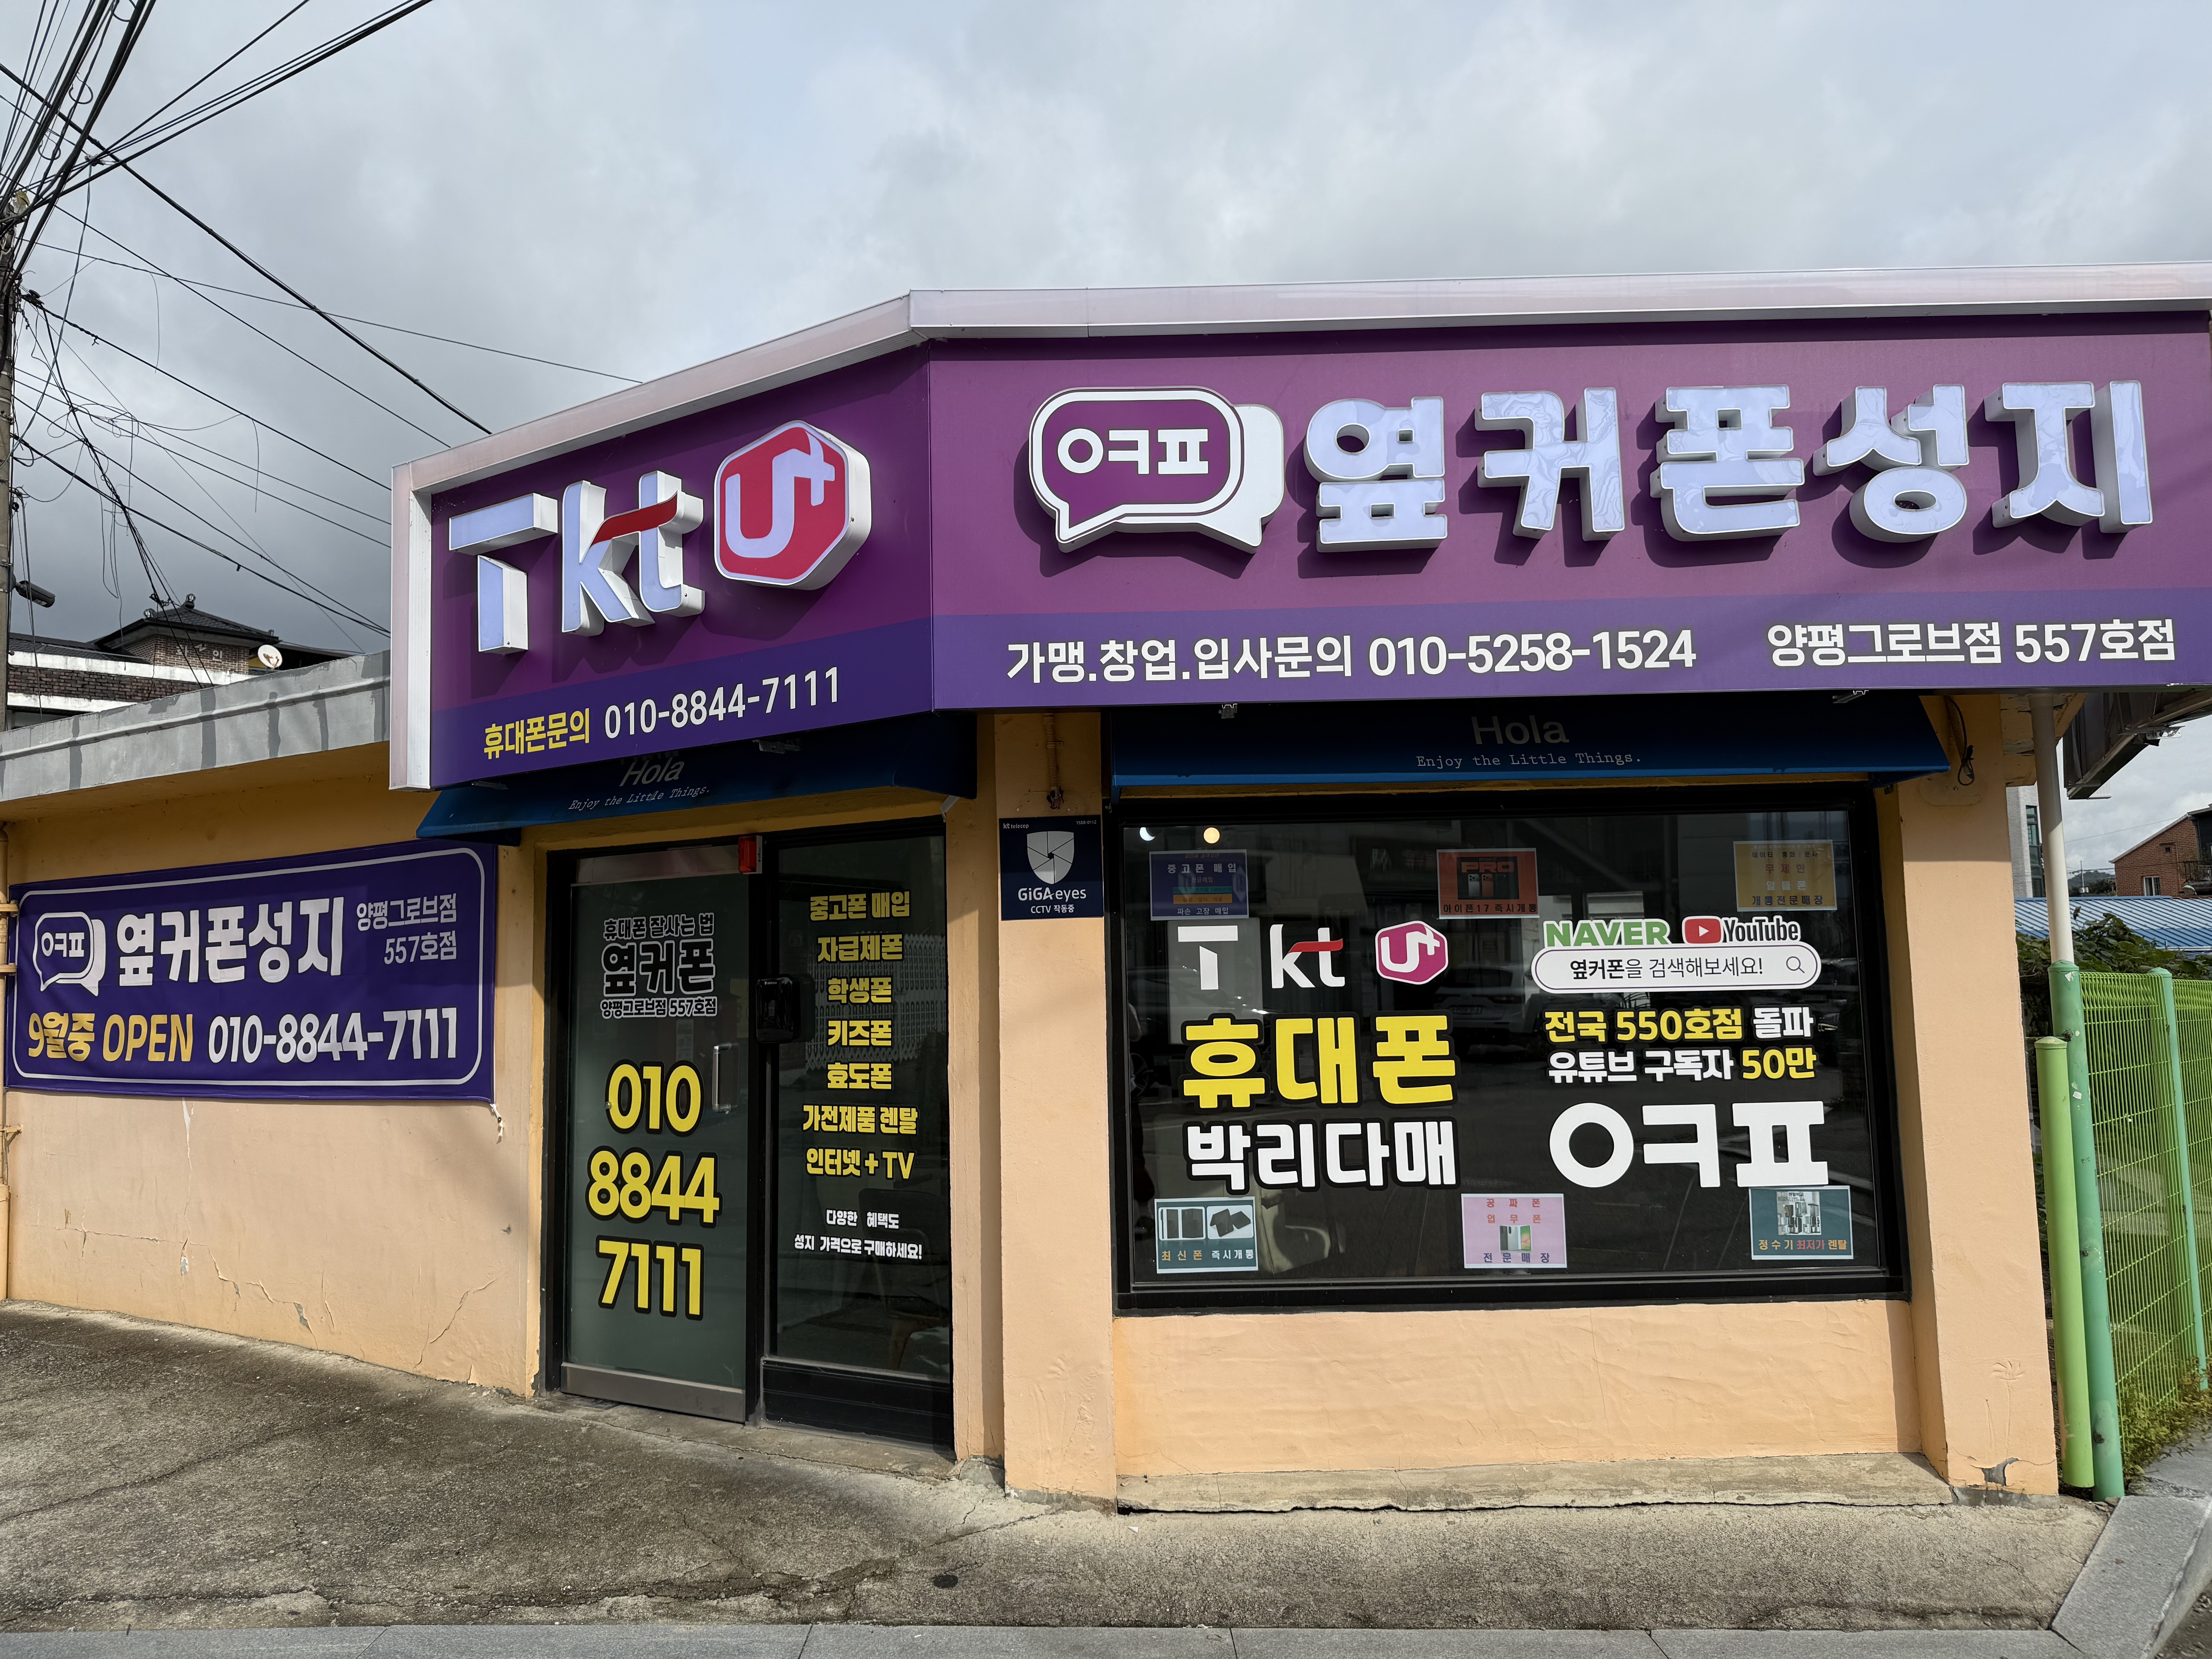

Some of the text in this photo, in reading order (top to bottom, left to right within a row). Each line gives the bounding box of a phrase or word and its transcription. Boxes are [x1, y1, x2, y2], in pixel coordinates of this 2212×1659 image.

[1304, 380, 2152, 552] 옆커폰성지
[562, 471, 704, 636] kt
[1007, 629, 1697, 683] 가맹.창업.입사문의 010-5258-1524
[1768, 618, 2176, 666] 양평그로브점 557호점
[483, 667, 839, 760] 휴대폰문의 010-8844-7111
[1472, 715, 1569, 745] Hola
[620, 758, 684, 787] Hola
[1416, 752, 1641, 769] Enjoy the Little Things.
[568, 786, 710, 811] Enjoy the Little Things.
[1214, 863, 1236, 873] 매입
[1461, 861, 1515, 873] PRO
[356, 893, 457, 932] 양평그로브점
[809, 891, 910, 922] 중고폰 매입
[1030, 904, 1075, 914] CCTV 작동중
[1443, 903, 1537, 913] 아이폰17 즉시개통
[116, 896, 344, 987] 옆커폰성지
[603, 912, 714, 942] 휴대폰 잘사는 법
[1546, 918, 1798, 947] NAVER YouTube
[383, 930, 458, 965] 557호점
[817, 933, 903, 963] 자급제폰
[1270, 924, 1345, 988] kt
[601, 938, 716, 997] 옆커폰
[1570, 956, 1762, 980] 옆커폰을 검색해보세요!
[828, 976, 892, 1004] 학생폰
[601, 998, 666, 1019] 양평그로브점
[668, 996, 718, 1017] 557호점
[28, 1007, 457, 1063] 9월중 OPEN 010-8844-7111
[828, 1019, 892, 1047] 키즈폰
[1544, 1007, 1813, 1043] 전국 550호점 돌파
[826, 1063, 892, 1090] 효도폰
[1183, 1015, 1455, 1108] 휴대폰
[1549, 1047, 1815, 1084] 유튜브 구독자 50만
[608, 1064, 701, 1133] 010
[802, 1105, 918, 1135] 가전제품 렌탈
[1187, 1121, 1456, 1190] 박리다매
[588, 1150, 720, 1224] 8844
[826, 1210, 899, 1230] 다양한 혜택도
[794, 1234, 922, 1259] 성지 가격으로 구매하세요!
[1212, 1249, 1254, 1259] 즉시개통
[1759, 1240, 1847, 1250] 정수기 최저가 렌탈
[598, 1240, 701, 1316] 7111
